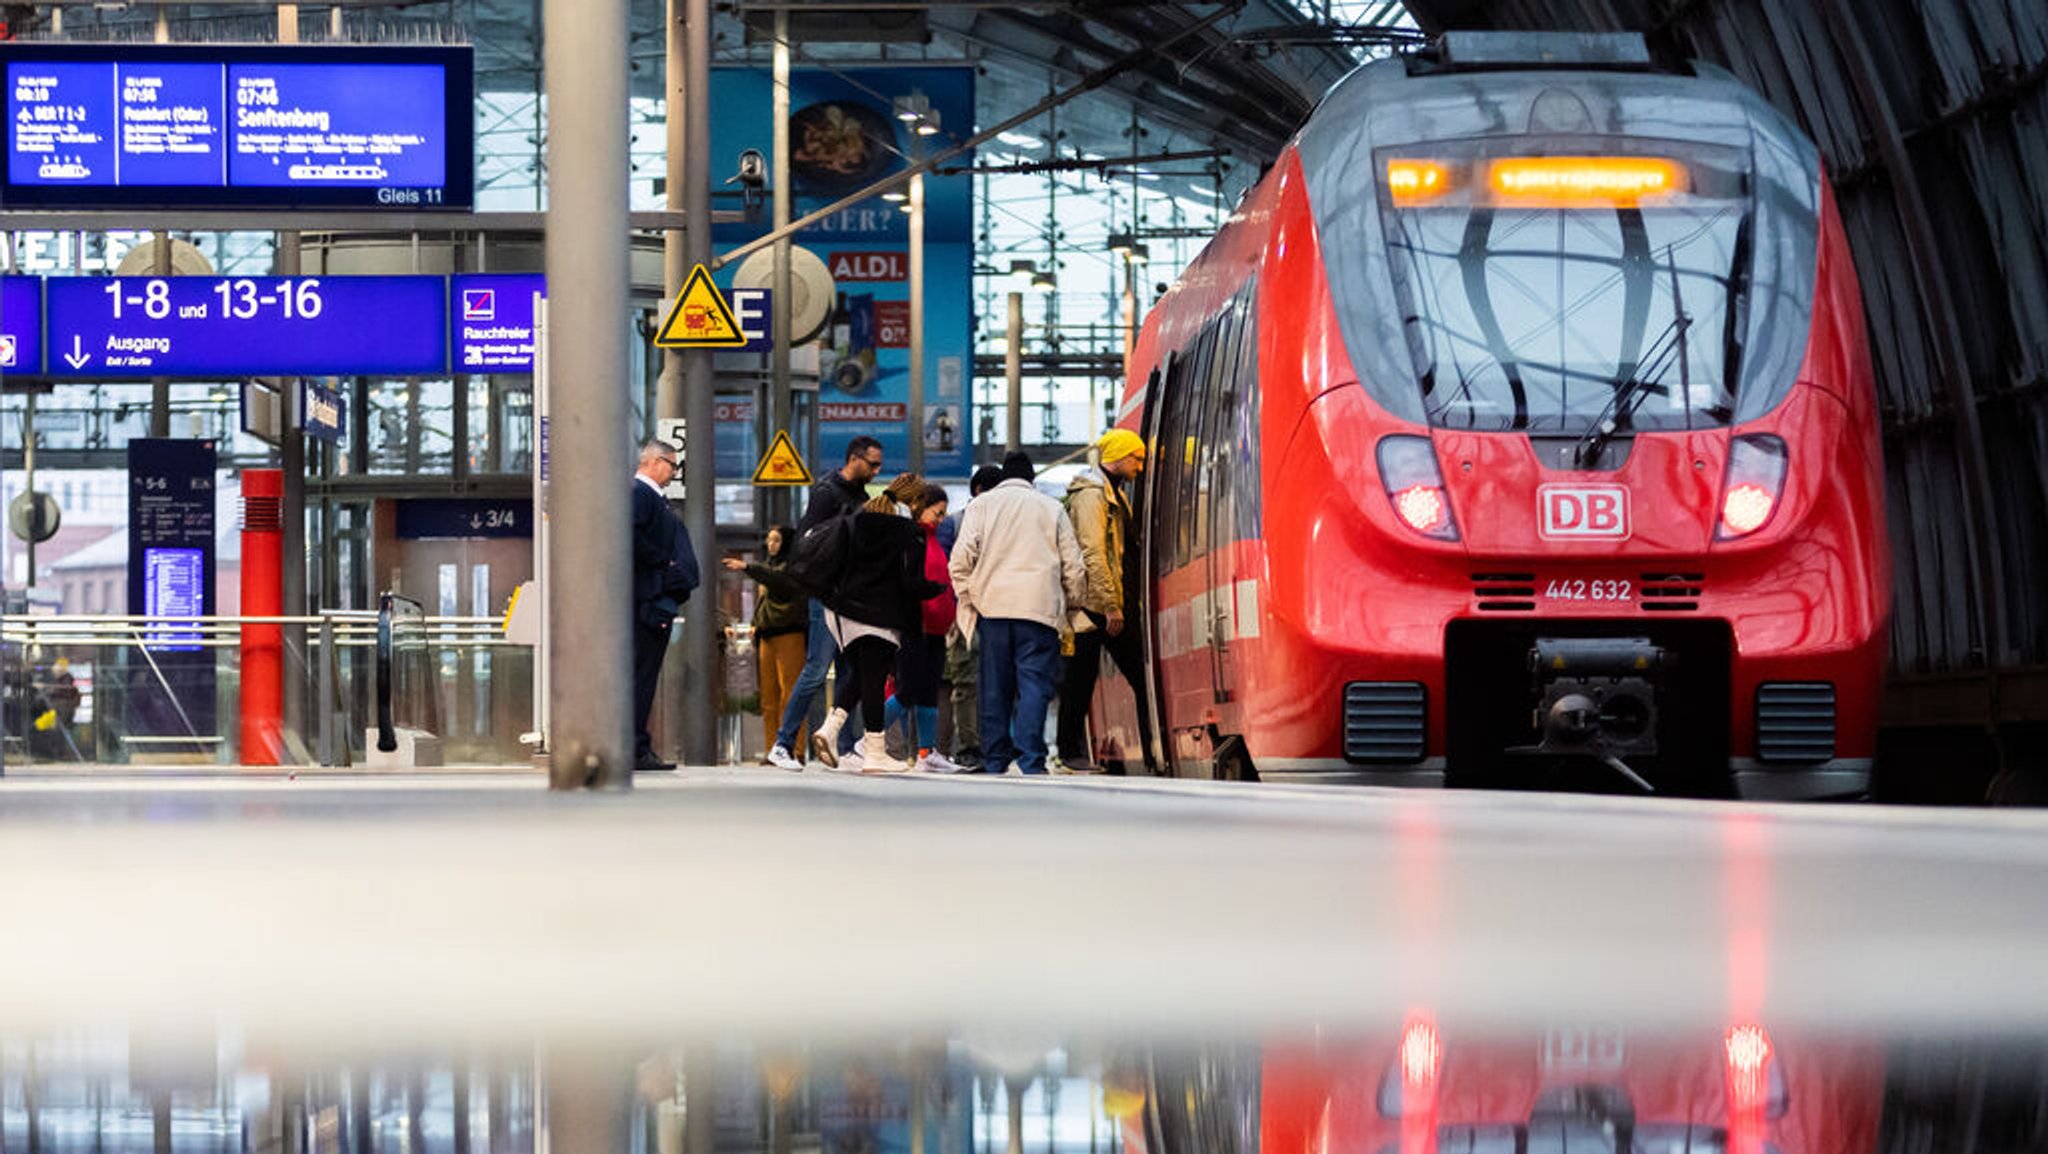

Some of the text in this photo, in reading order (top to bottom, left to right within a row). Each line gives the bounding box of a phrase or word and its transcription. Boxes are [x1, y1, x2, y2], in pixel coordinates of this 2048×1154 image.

[237, 107, 330, 131] Senftenberg
[377, 188, 442, 204] Gleis 11
[105, 279, 322, 319] 1-8 und 13-16
[733, 292, 764, 339] E
[464, 327, 530, 340] Rauchfreier
[106, 336, 170, 353] Ausgang
[146, 477, 167, 490] 5-6
[487, 510, 514, 527] 3/4
[1549, 493, 1619, 531] DB
[1545, 580, 1631, 600] 442 632
